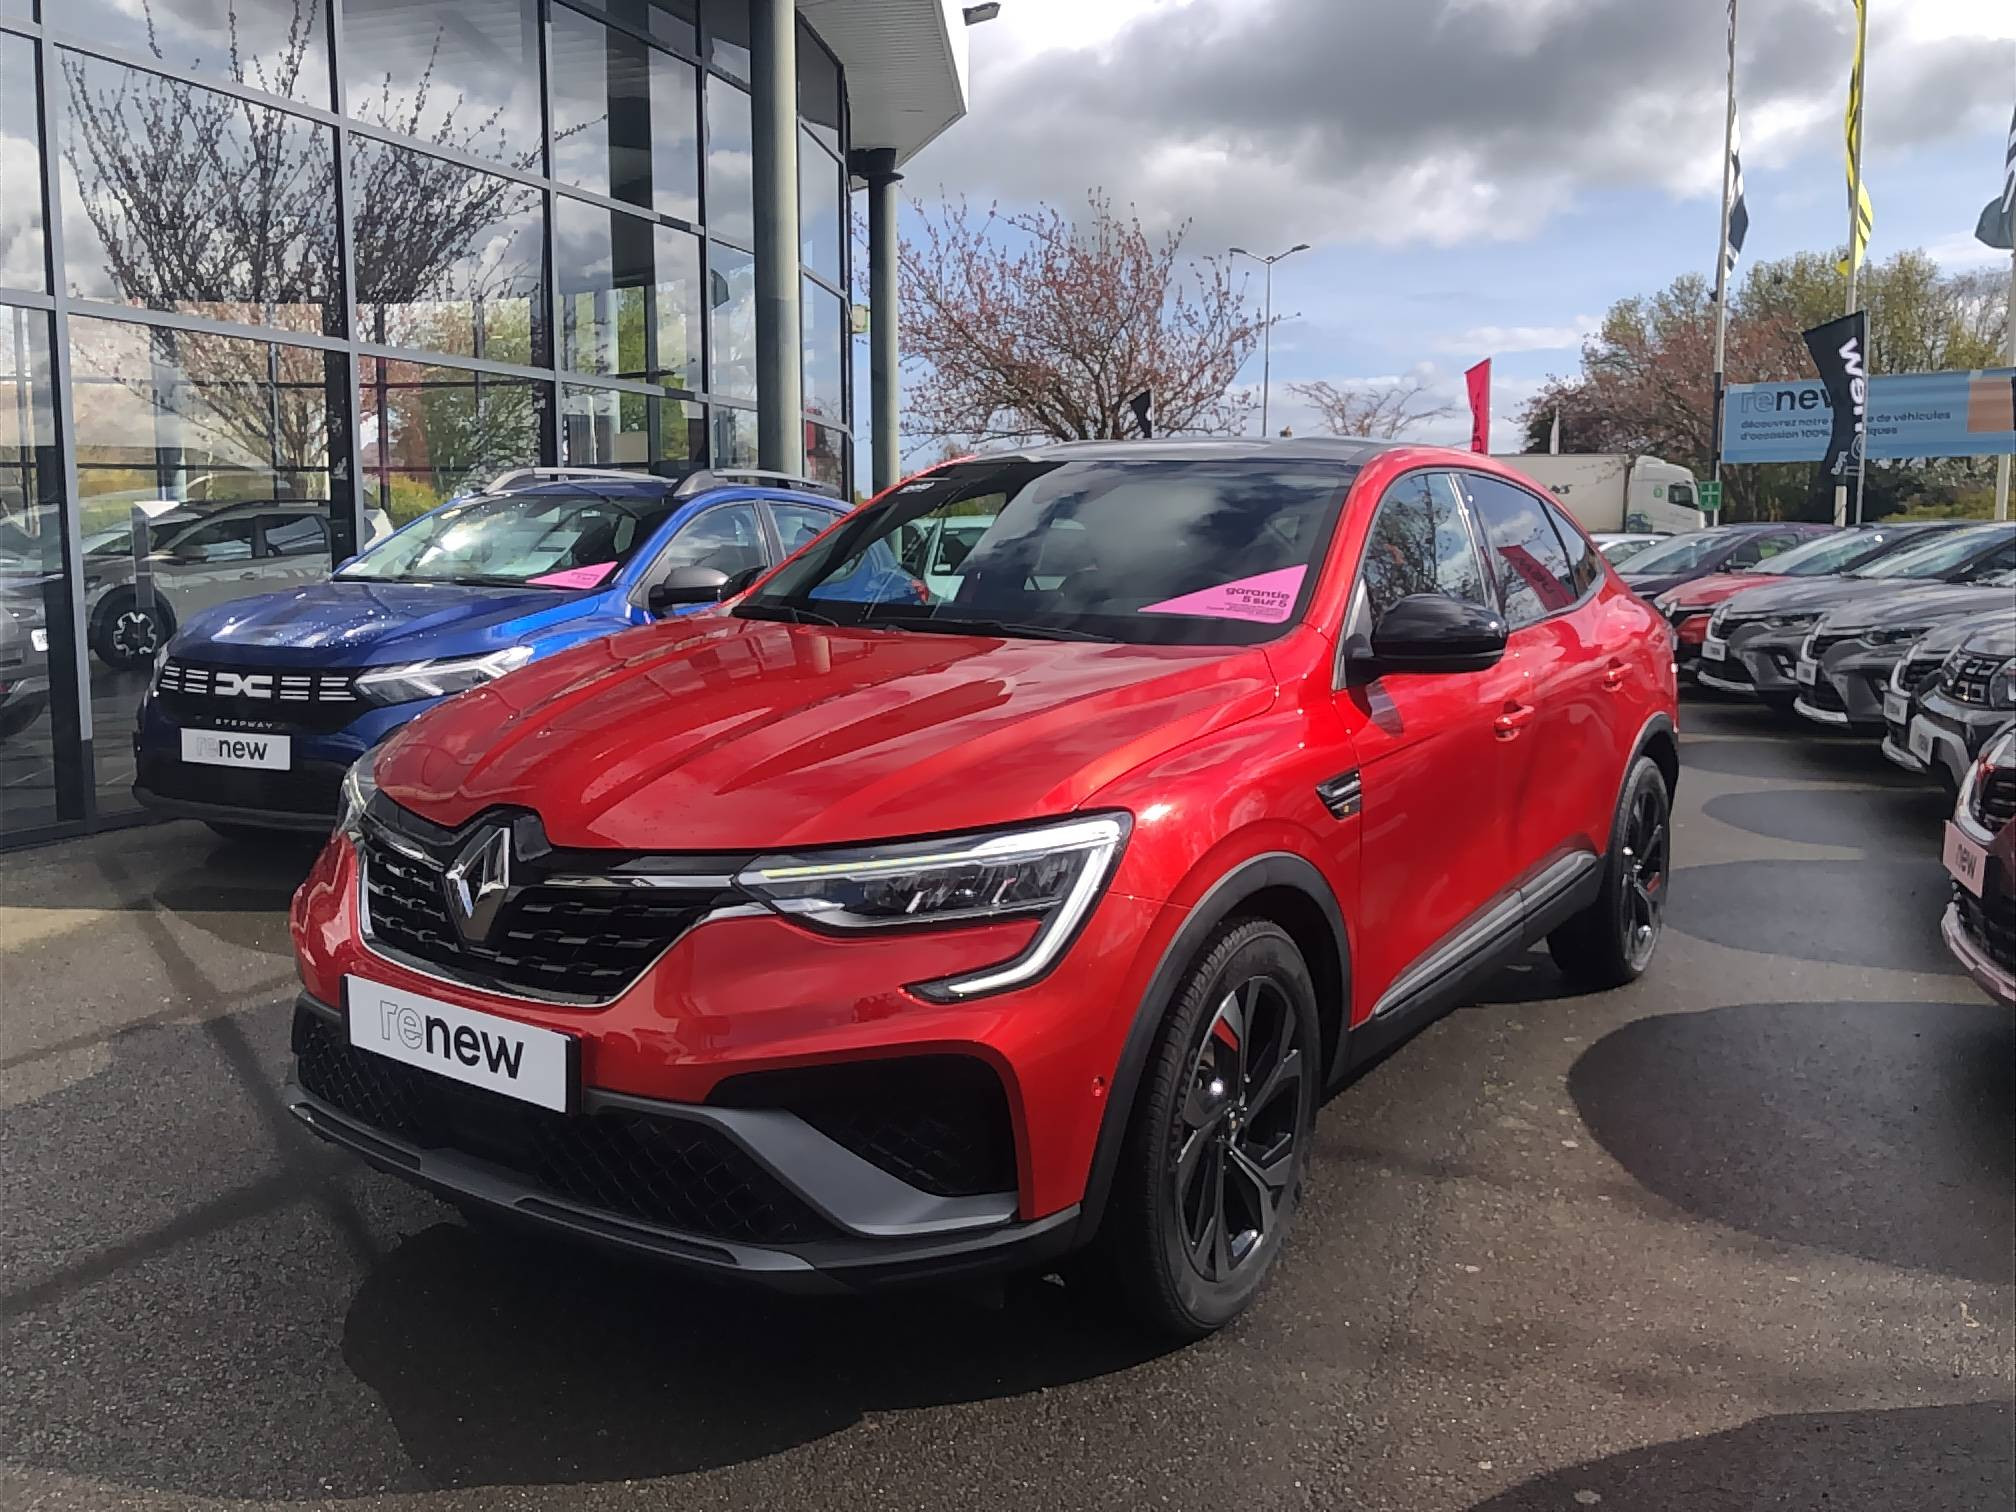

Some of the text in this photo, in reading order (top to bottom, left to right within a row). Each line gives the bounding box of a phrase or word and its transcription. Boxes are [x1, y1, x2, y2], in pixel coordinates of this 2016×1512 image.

[1876, 414, 1890, 422] de
[1894, 410, 1951, 421] véhicules
[1799, 418, 1829, 426] notre
[1741, 431, 1799, 440] d'occasion
[1226, 588, 1290, 600] garantie
[1253, 598, 1276, 606] sur
[1279, 600, 1287, 608] 5
[215, 718, 273, 729] STEPWAY
[197, 737, 268, 761] renew
[380, 1000, 524, 1080] renew
